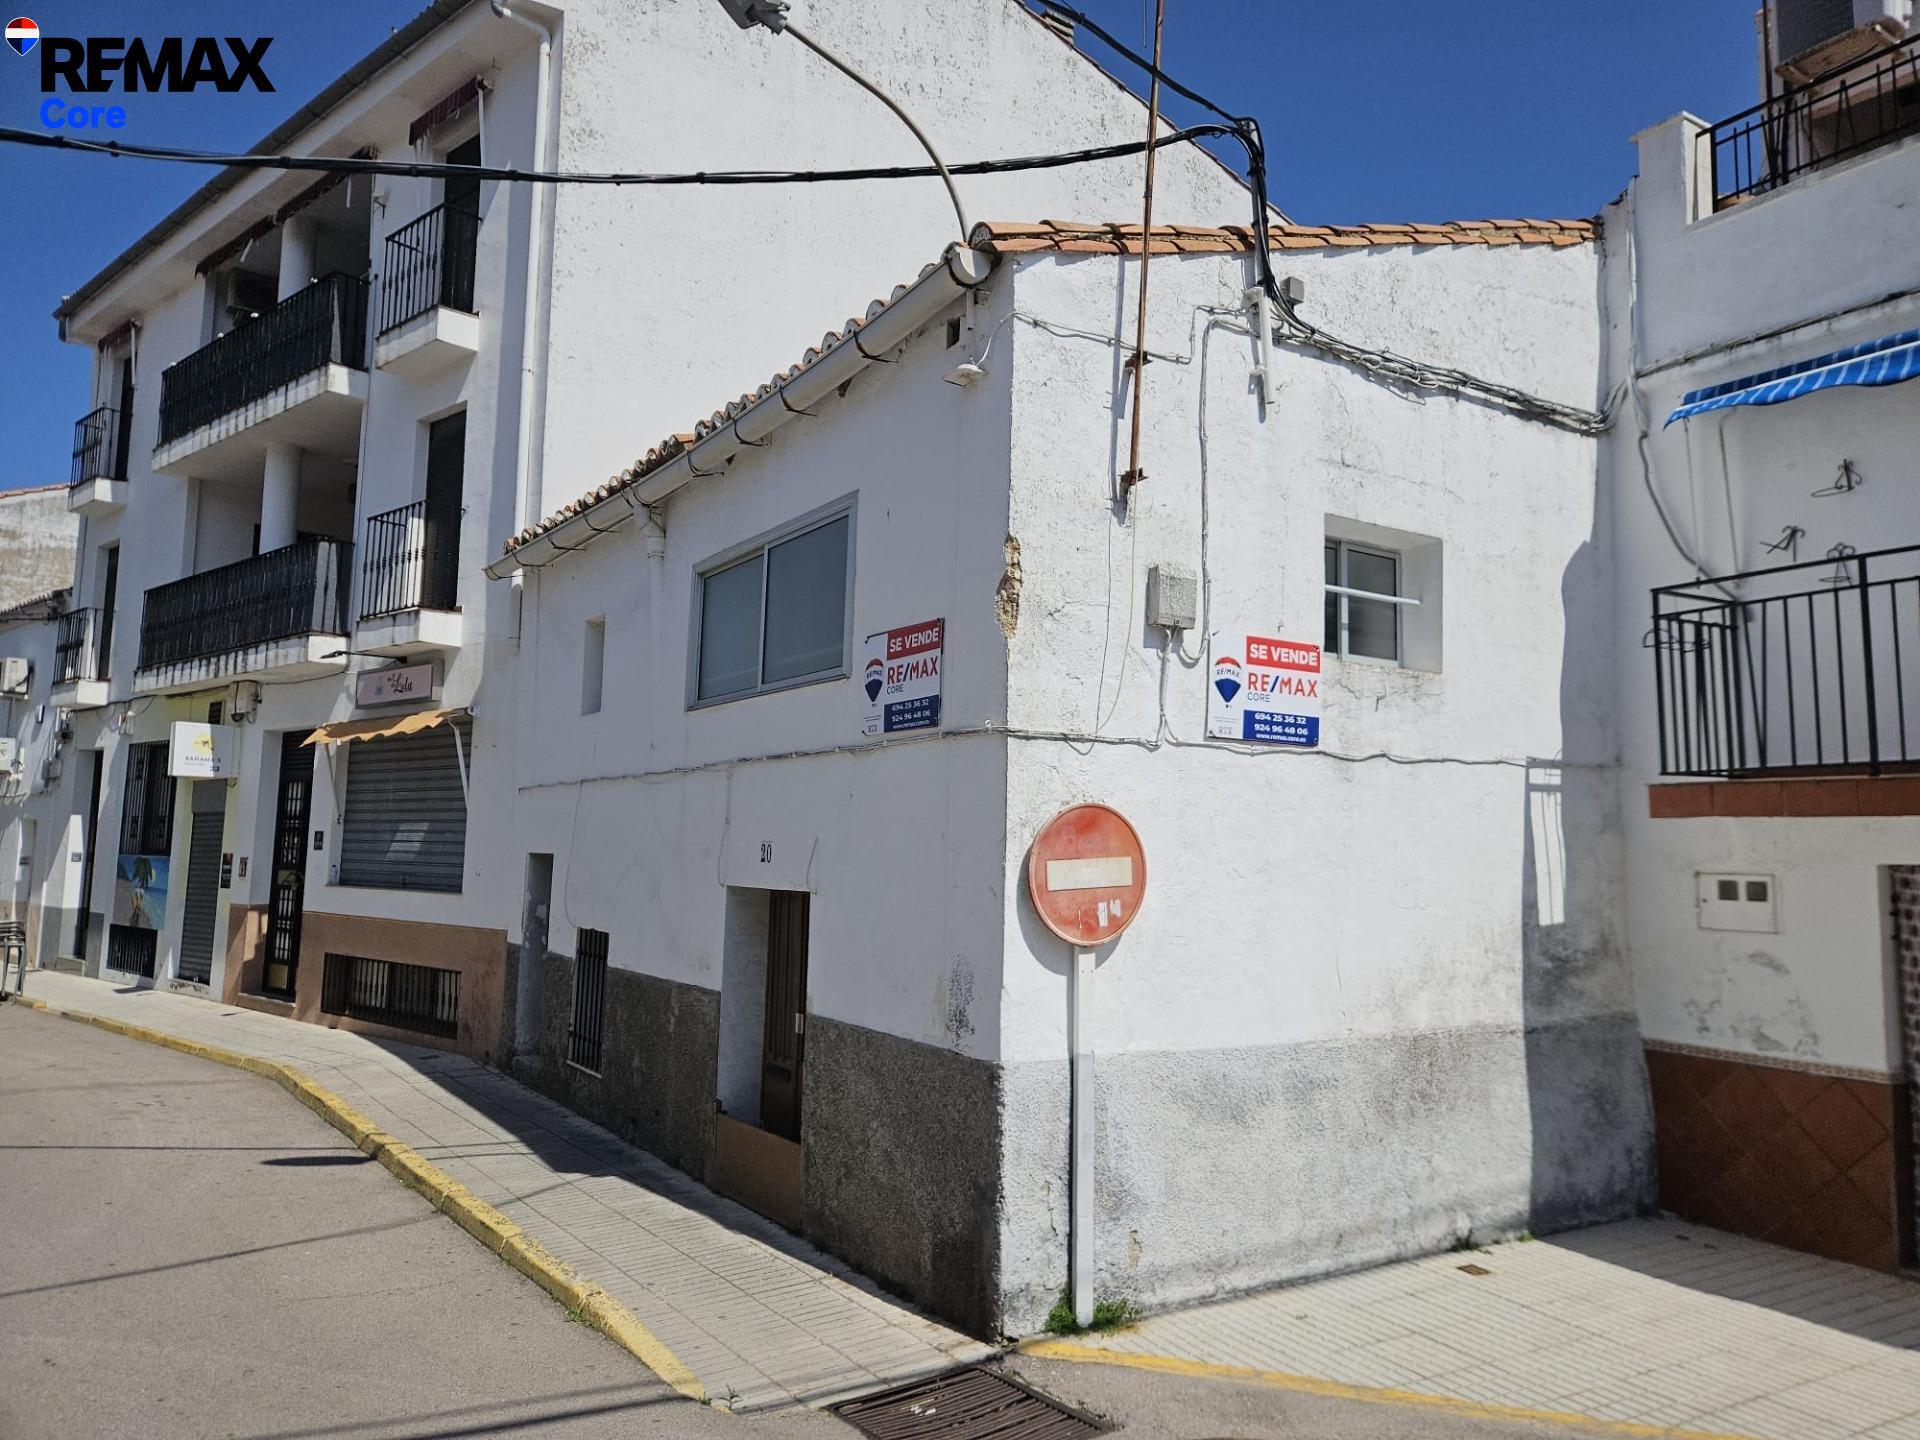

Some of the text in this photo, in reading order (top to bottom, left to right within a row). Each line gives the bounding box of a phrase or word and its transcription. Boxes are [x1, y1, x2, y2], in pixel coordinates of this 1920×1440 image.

[889, 627, 940, 653] SE VENDE
[1249, 643, 1318, 666] SE VENDE
[887, 656, 939, 685] RE/MAX
[1216, 668, 1240, 677] RE/MAX
[887, 684, 904, 695] CORE
[1247, 672, 1318, 698] RE/MAX
[1247, 692, 1271, 702] CORE
[1254, 712, 1306, 725] 694 25 36 32
[1254, 723, 1308, 736] 924 96 48 06
[760, 843, 772, 864] 20
